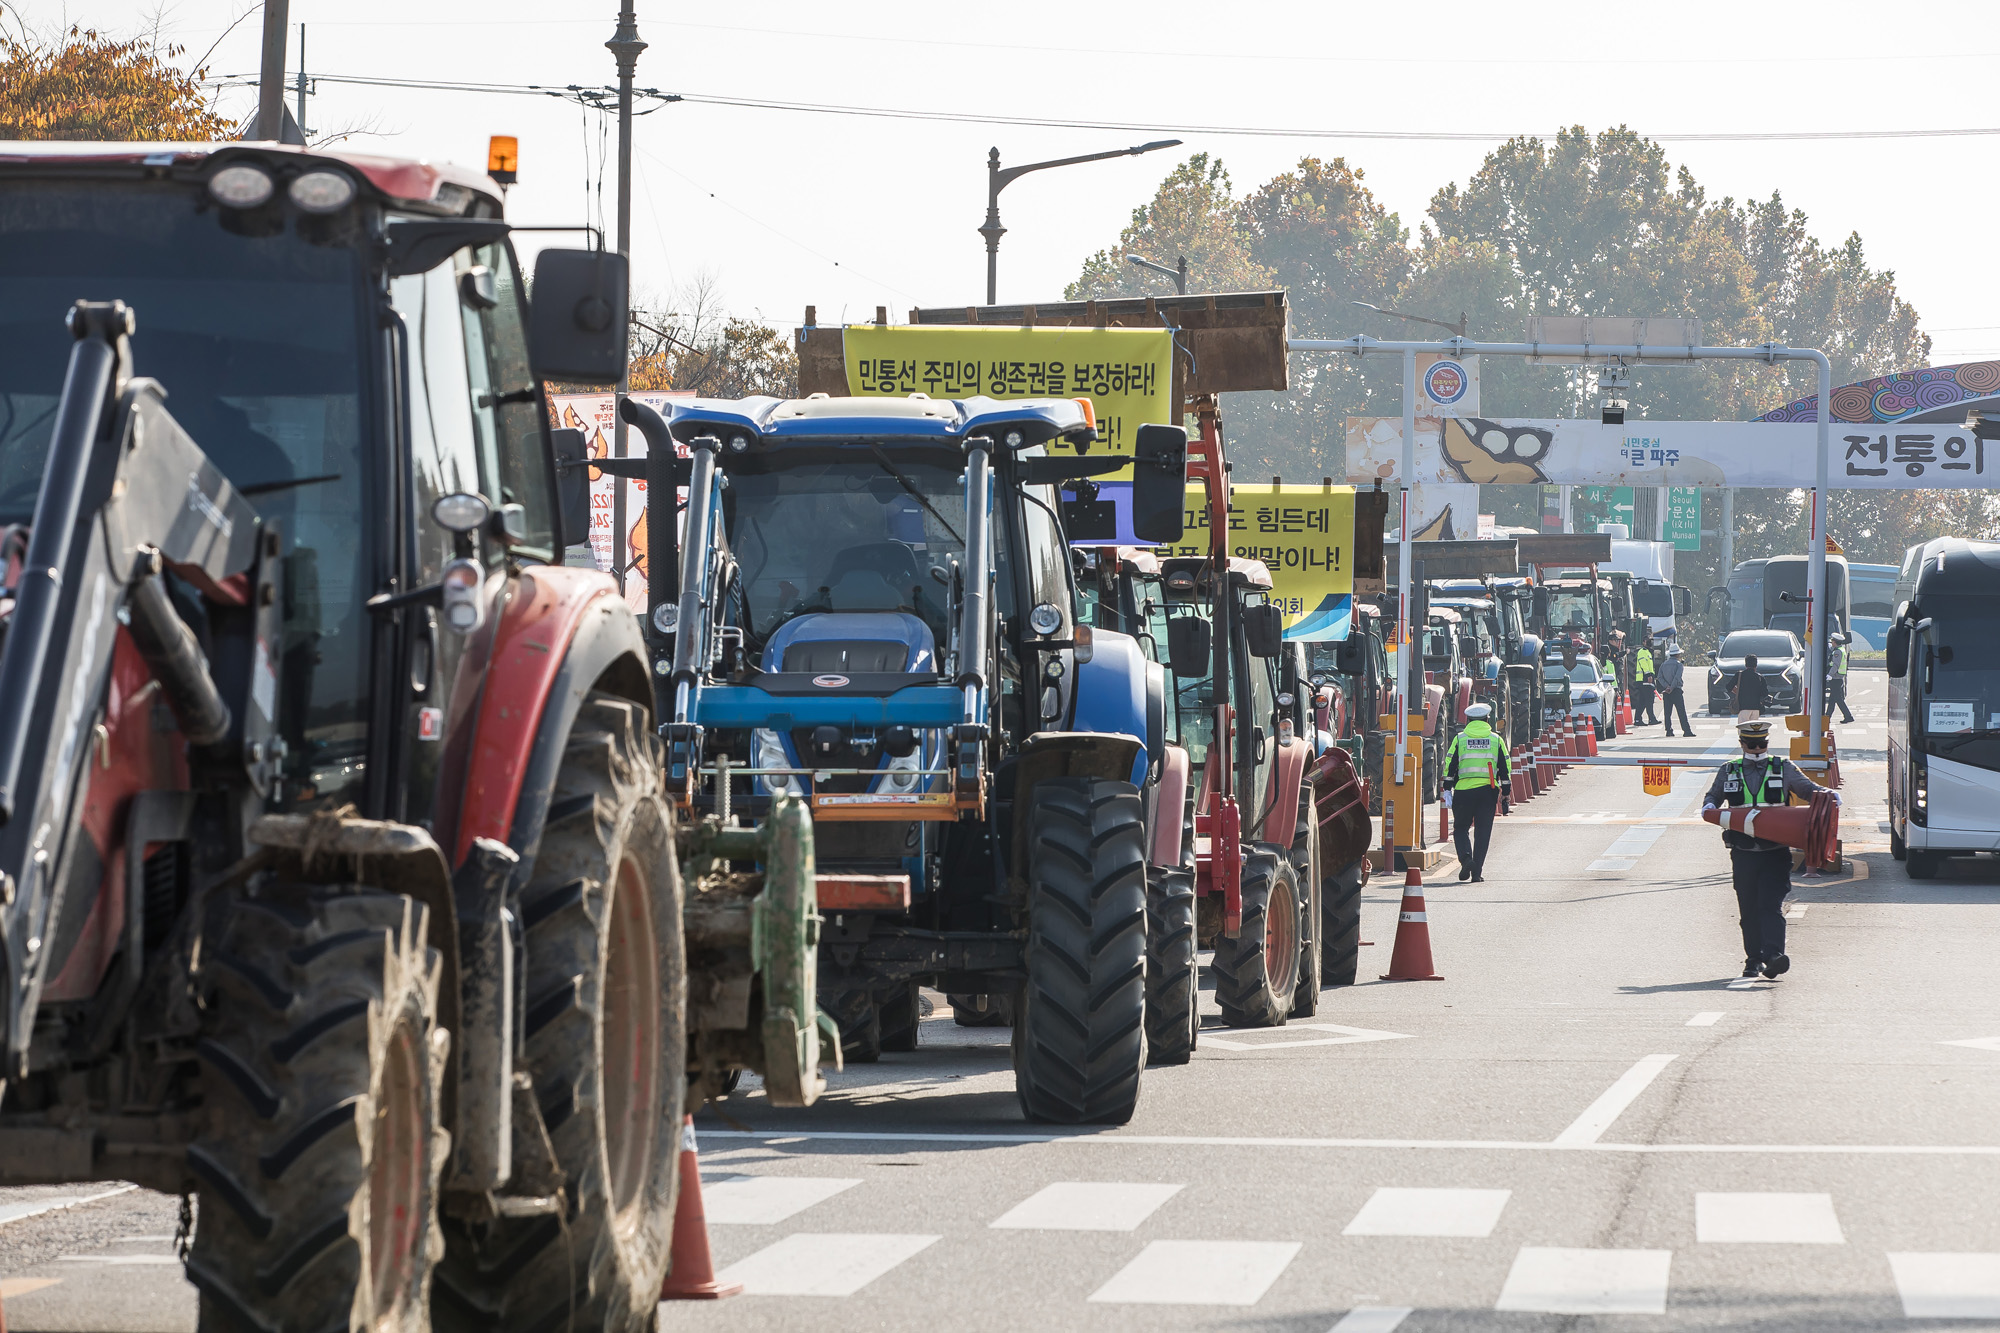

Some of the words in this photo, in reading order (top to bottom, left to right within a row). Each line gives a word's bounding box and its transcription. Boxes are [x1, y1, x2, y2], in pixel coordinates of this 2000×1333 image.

[858, 359, 916, 392] 민통선
[922, 360, 981, 393] 주민의
[987, 360, 1066, 394] 생존권을
[1071, 362, 1155, 396] 보장하라!
[1438, 385, 1455, 395] 축제
[1621, 437, 1660, 448] 시민중심
[1620, 449, 1628, 459] 더
[1631, 449, 1645, 466] 큰
[1650, 449, 1679, 466] 파주
[1843, 434, 1984, 477] 전통의
[1672, 496, 1692, 504] Seoul
[1256, 507, 1329, 533] 힘든데
[1672, 506, 1696, 519] 문산
[1672, 532, 1696, 540] Munsan
[1644, 767, 1669, 786] 일시정지
